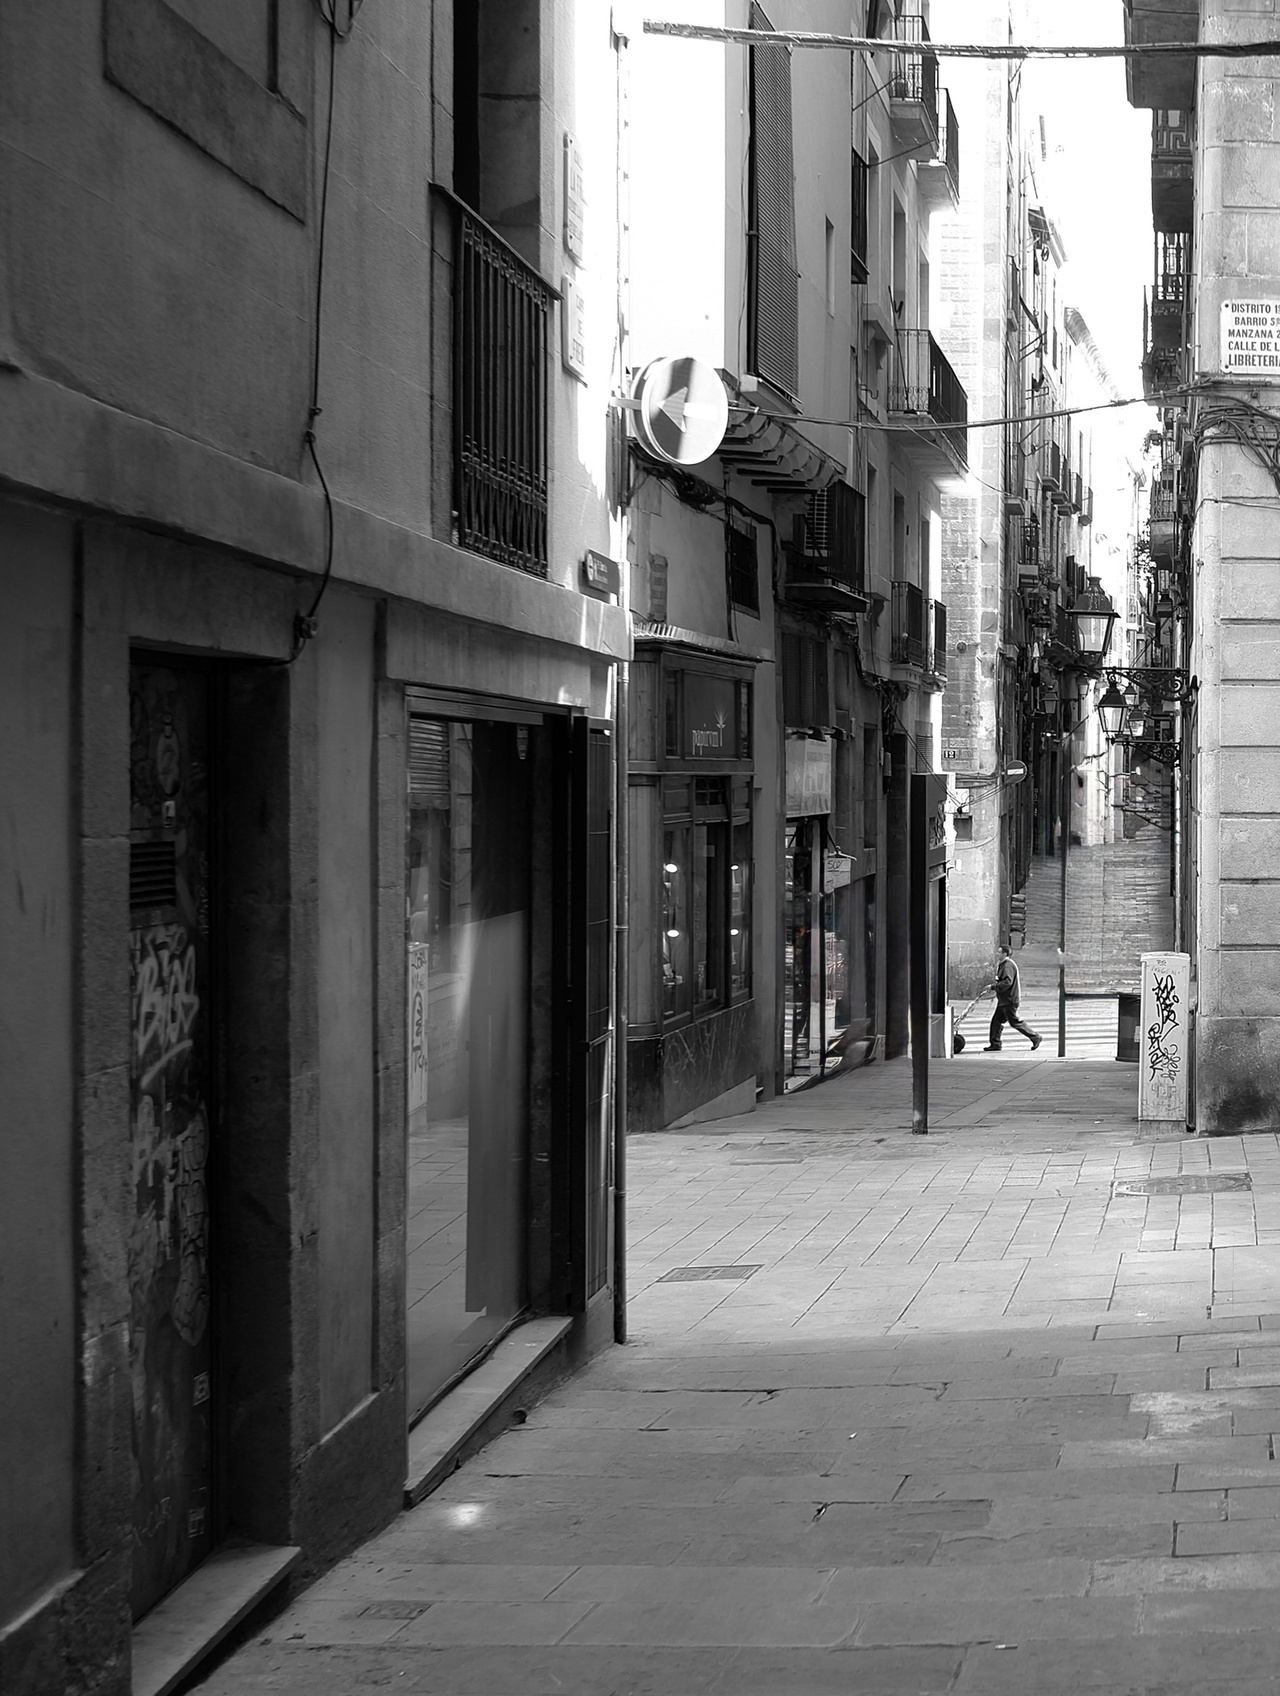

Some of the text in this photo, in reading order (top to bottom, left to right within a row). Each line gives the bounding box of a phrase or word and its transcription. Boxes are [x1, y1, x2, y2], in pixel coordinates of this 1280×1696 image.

[1231, 303, 1271, 314] DISTRITO
[1234, 316, 1268, 326] BARRIO
[1228, 329, 1273, 339] MANZANA
[1228, 341, 1257, 351] CALLE
[1260, 341, 1272, 352] DE
[944, 750, 955, 759] 12
